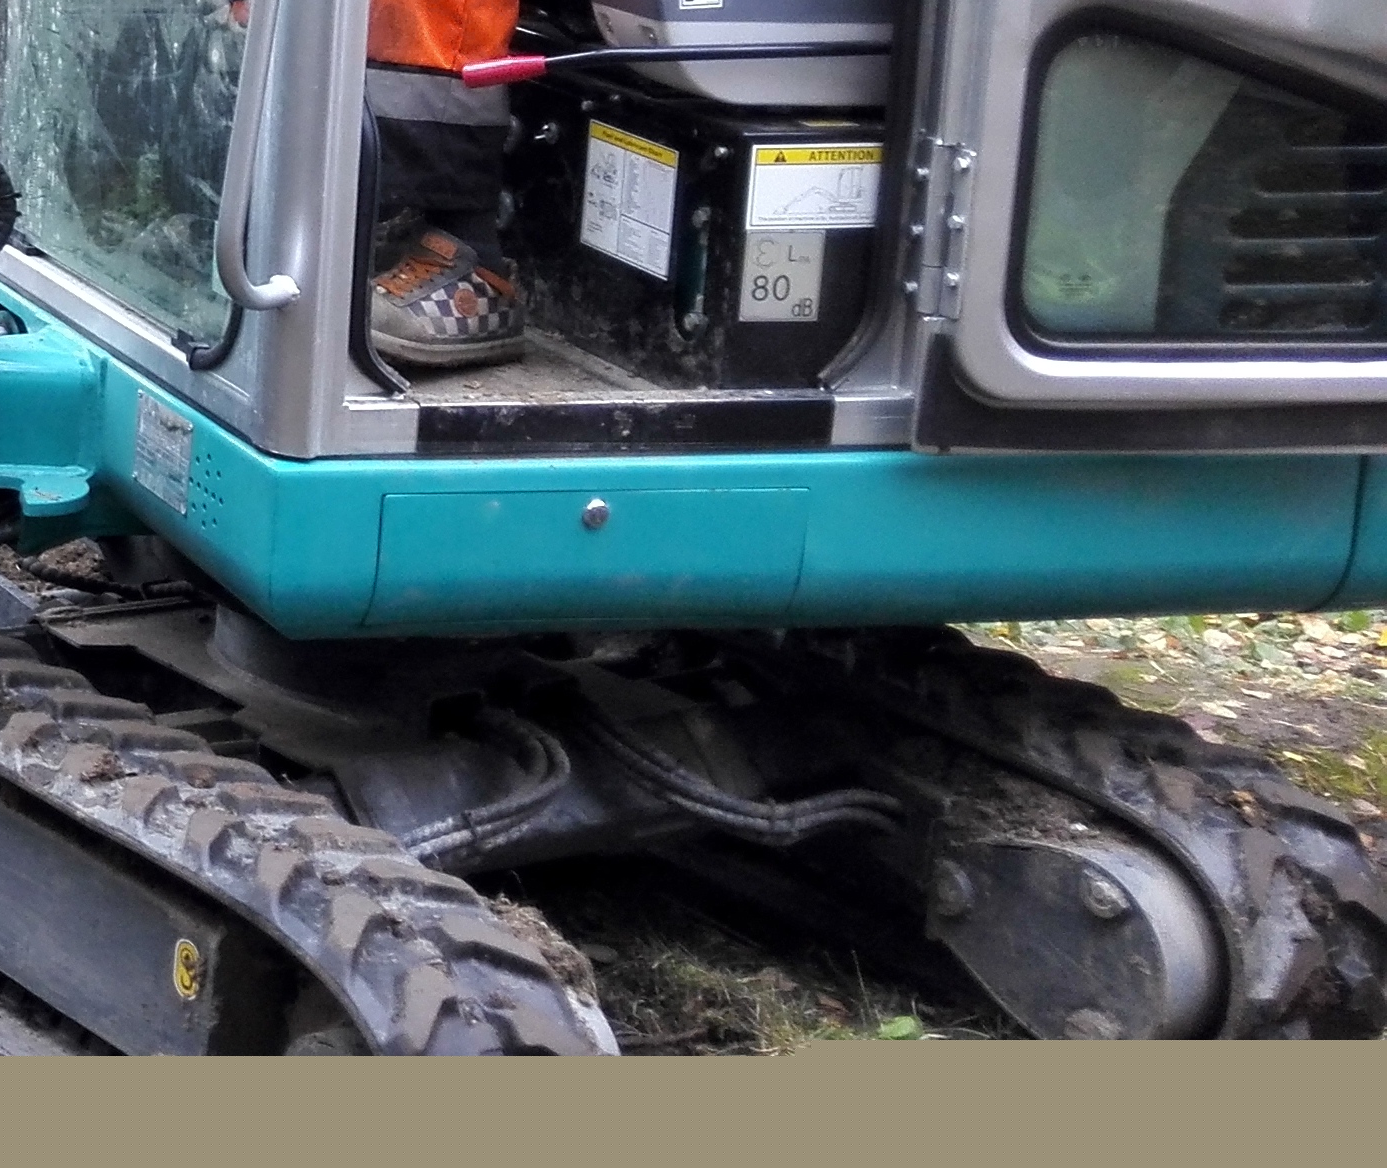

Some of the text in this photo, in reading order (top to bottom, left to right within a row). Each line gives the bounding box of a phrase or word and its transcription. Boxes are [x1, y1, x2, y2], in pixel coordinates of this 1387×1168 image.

[809, 150, 874, 161] ATTENTION
[752, 275, 791, 301] 80
[792, 298, 813, 317] dB
